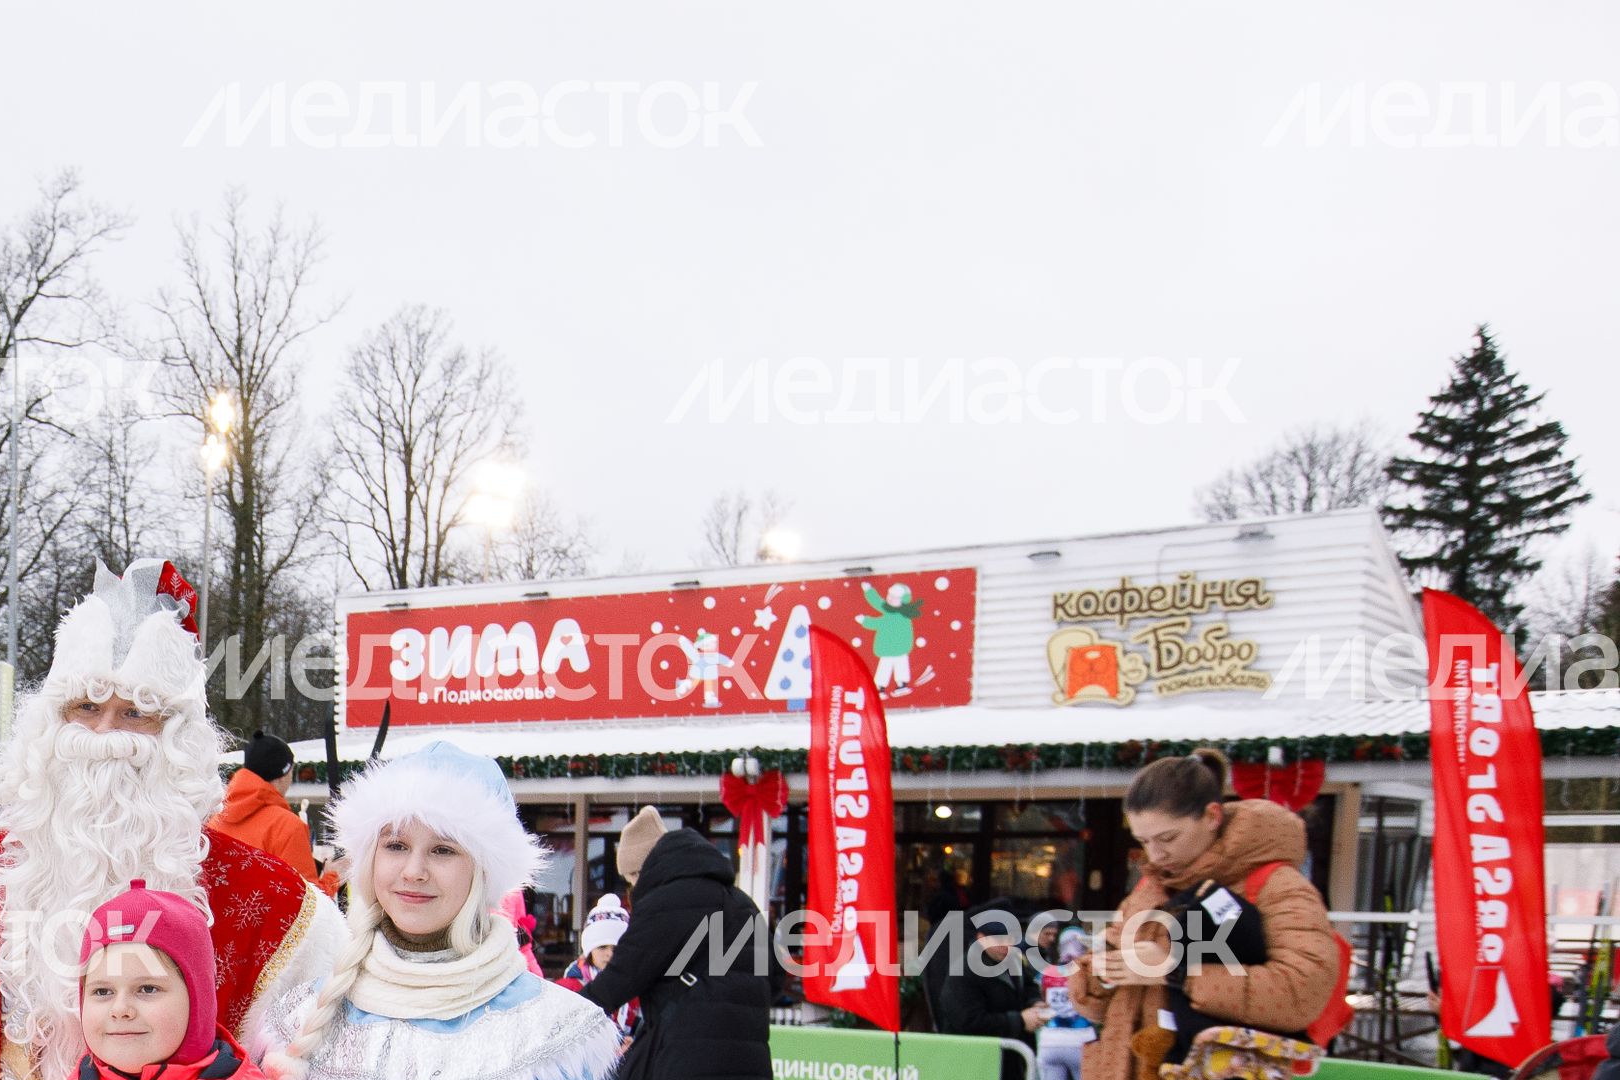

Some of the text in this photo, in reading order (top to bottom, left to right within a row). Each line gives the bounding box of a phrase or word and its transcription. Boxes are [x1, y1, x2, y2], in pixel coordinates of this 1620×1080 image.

[1132, 620, 1256, 673] Бобро
[418, 685, 557, 706] в Подмосковье
